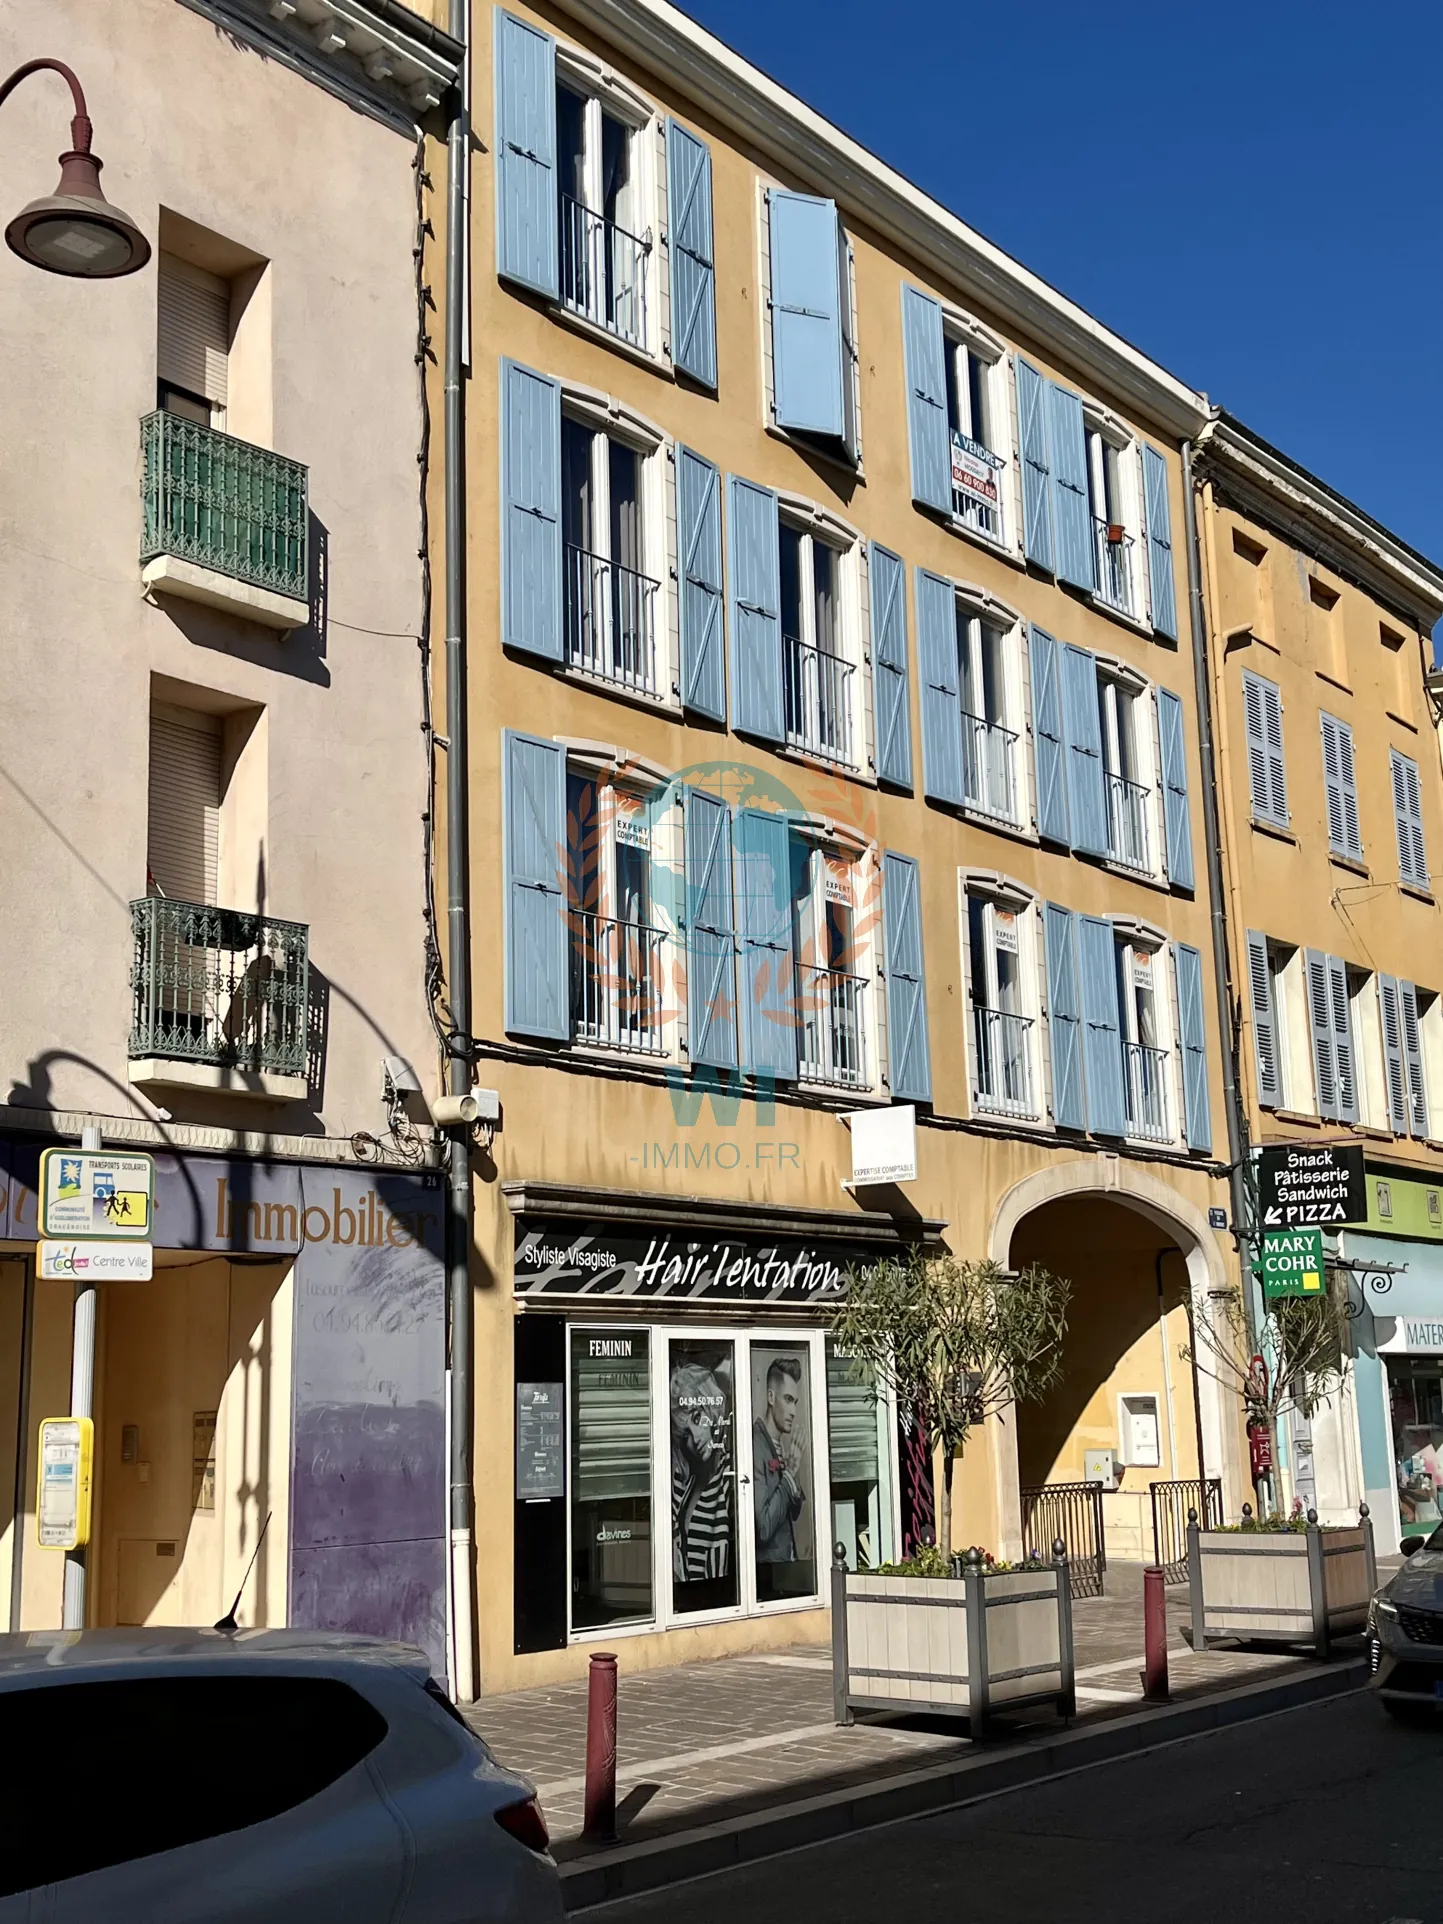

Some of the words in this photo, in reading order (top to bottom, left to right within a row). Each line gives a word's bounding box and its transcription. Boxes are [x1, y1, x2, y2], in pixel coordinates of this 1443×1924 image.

[954, 432, 961, 446] A
[963, 438, 996, 467] VENDRE
[954, 468, 962, 480] 06
[617, 820, 648, 836] EXPERT
[826, 881, 850, 893] EXPERT
[89, 1161, 120, 1170] TRANSPORTS
[122, 1162, 147, 1171] SCOLAIRES
[1287, 1151, 1333, 1168] Snack
[882, 1163, 914, 1174] COMPTABLE
[1274, 1167, 1350, 1186] Pâtisserie
[426, 1176, 437, 1187] 26
[1277, 1183, 1348, 1202] Sandwich
[215, 1177, 439, 1249] Immobilier
[1286, 1202, 1347, 1223] PIZZA
[1264, 1236, 1315, 1254] MARY
[93, 1255, 125, 1267] Centre
[127, 1256, 148, 1268] Ville
[524, 1244, 566, 1269] Styliste
[568, 1246, 617, 1272] Visagiste
[634, 1237, 710, 1285] Hair
[713, 1242, 841, 1290] Tentation
[1265, 1255, 1318, 1272] COHR
[1268, 1278, 1299, 1287] PARIS
[589, 1340, 632, 1356] FEMININ
[679, 1396, 724, 1407] 04.94.50.76.57
[596, 1523, 632, 1541] davines
